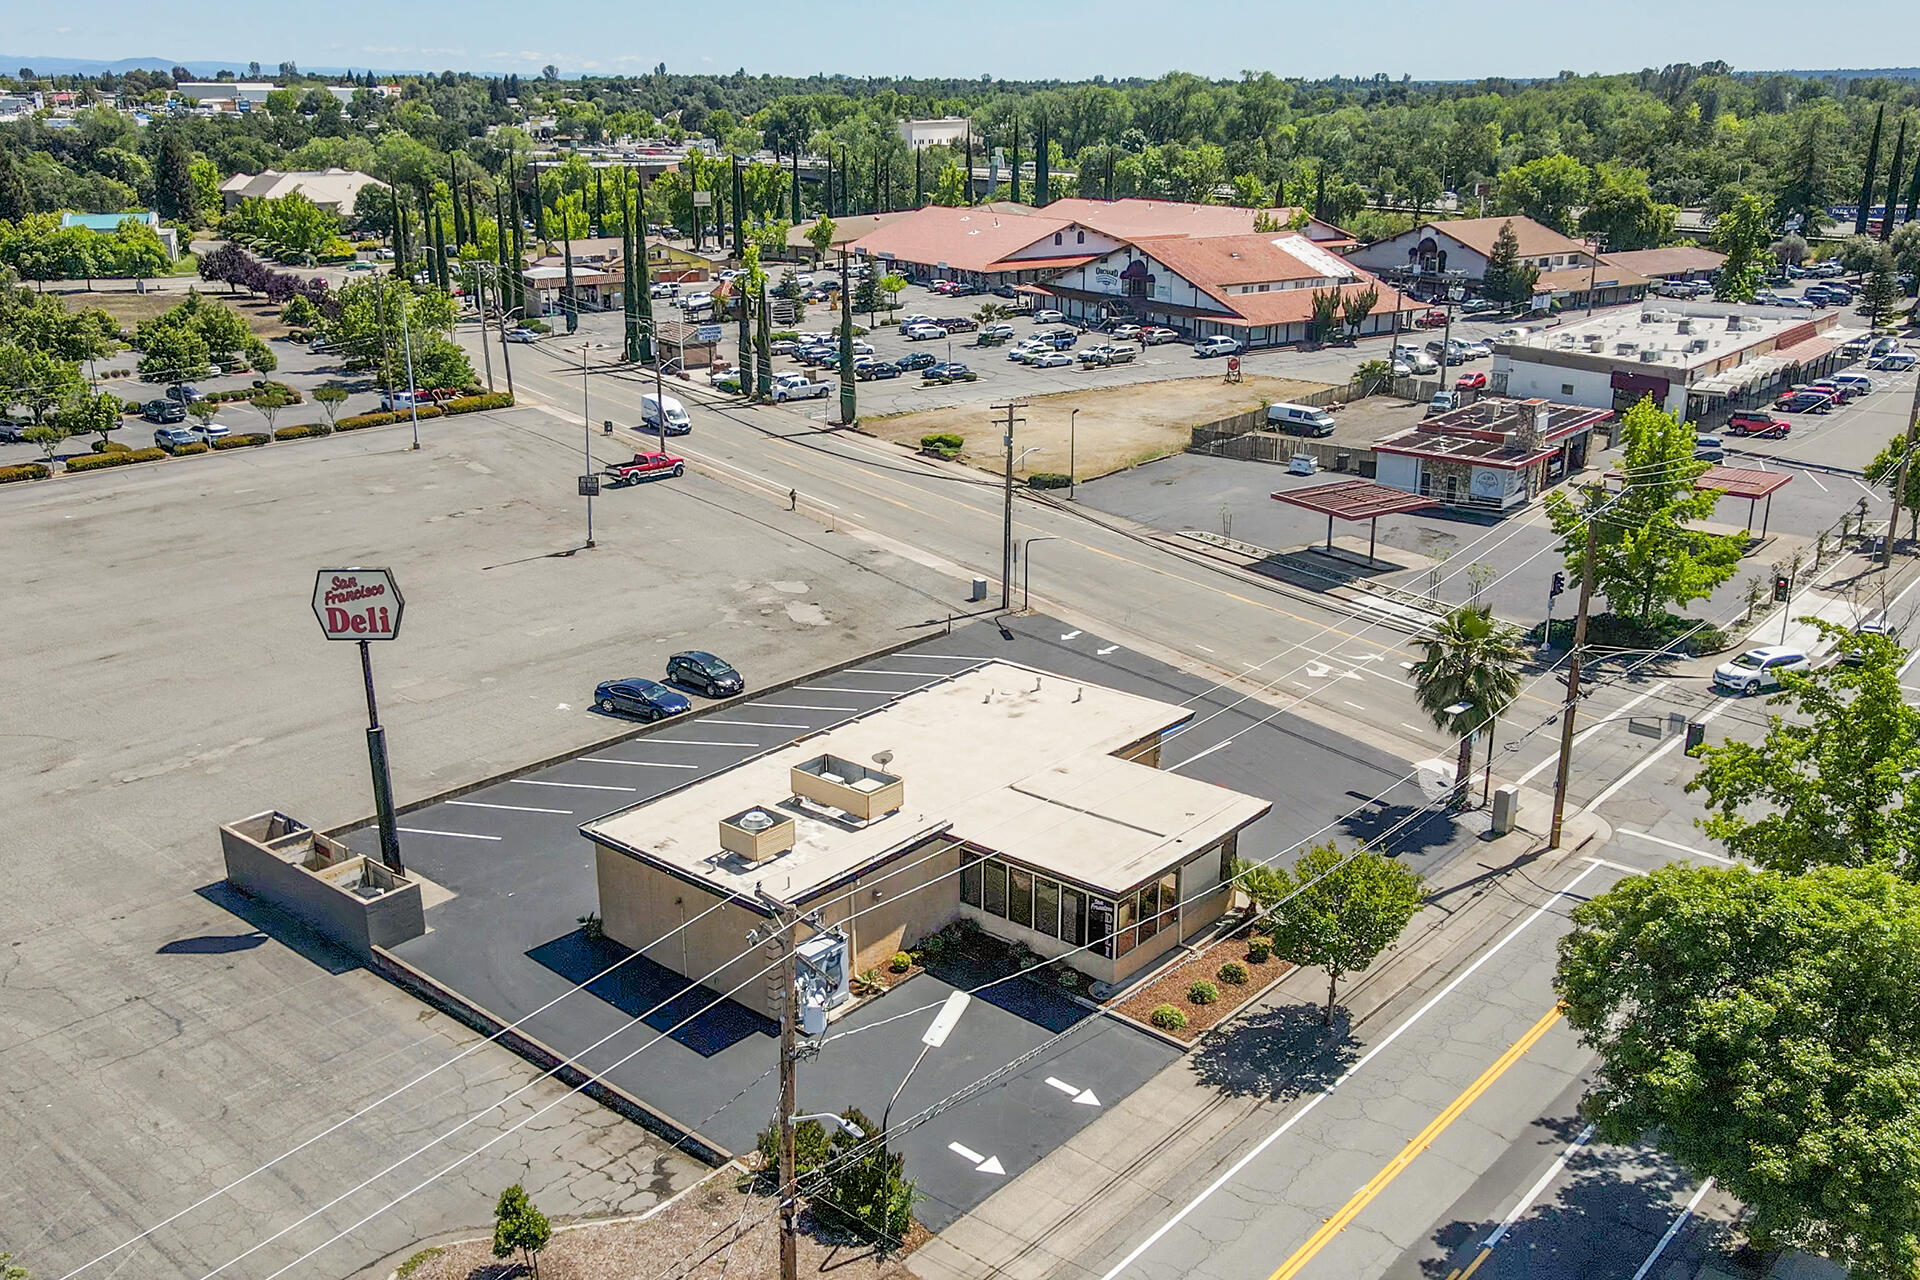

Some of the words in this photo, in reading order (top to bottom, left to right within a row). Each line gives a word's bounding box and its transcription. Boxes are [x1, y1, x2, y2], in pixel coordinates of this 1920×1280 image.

[324, 584, 385, 606] Francisco
[331, 576, 357, 591] San
[325, 607, 392, 634] Deli
[1105, 912, 1113, 957] DELI
